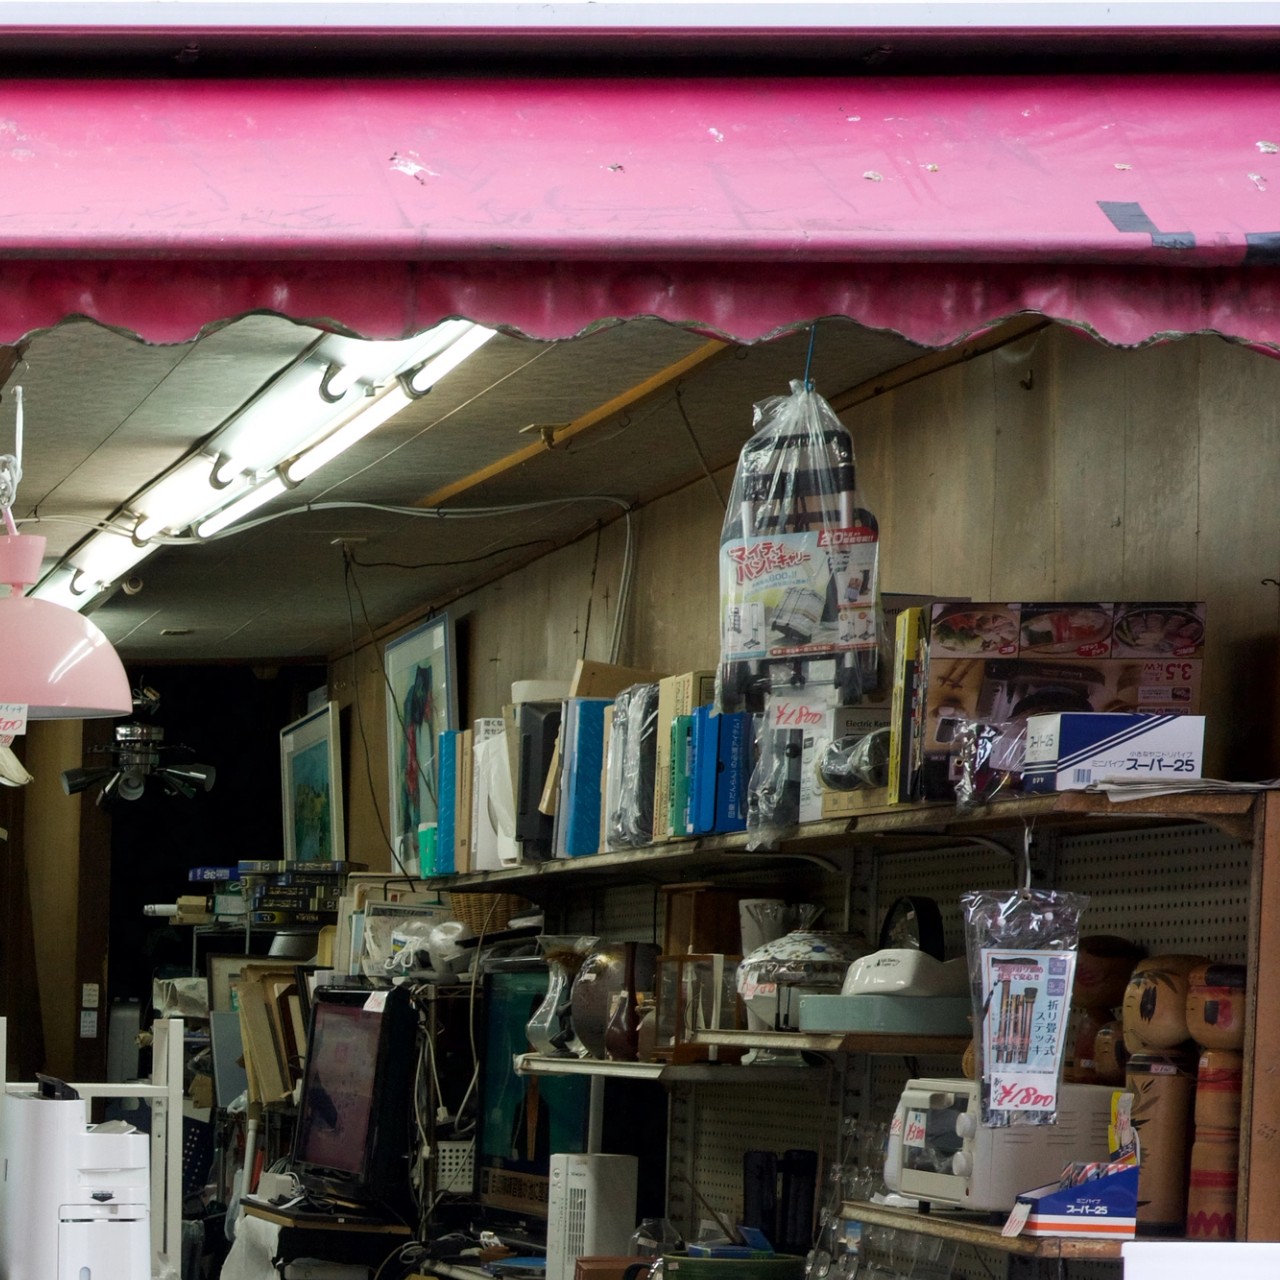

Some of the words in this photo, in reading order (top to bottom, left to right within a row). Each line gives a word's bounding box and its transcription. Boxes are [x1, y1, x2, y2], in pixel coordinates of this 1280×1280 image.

[728, 541, 785, 562] マイティ
[1126, 757, 1196, 773] スーパー25
[1033, 1011, 1046, 1056] ステッキ
[1044, 999, 1060, 1057] 折り畳み式
[1066, 1204, 1108, 1215] スーパー25
